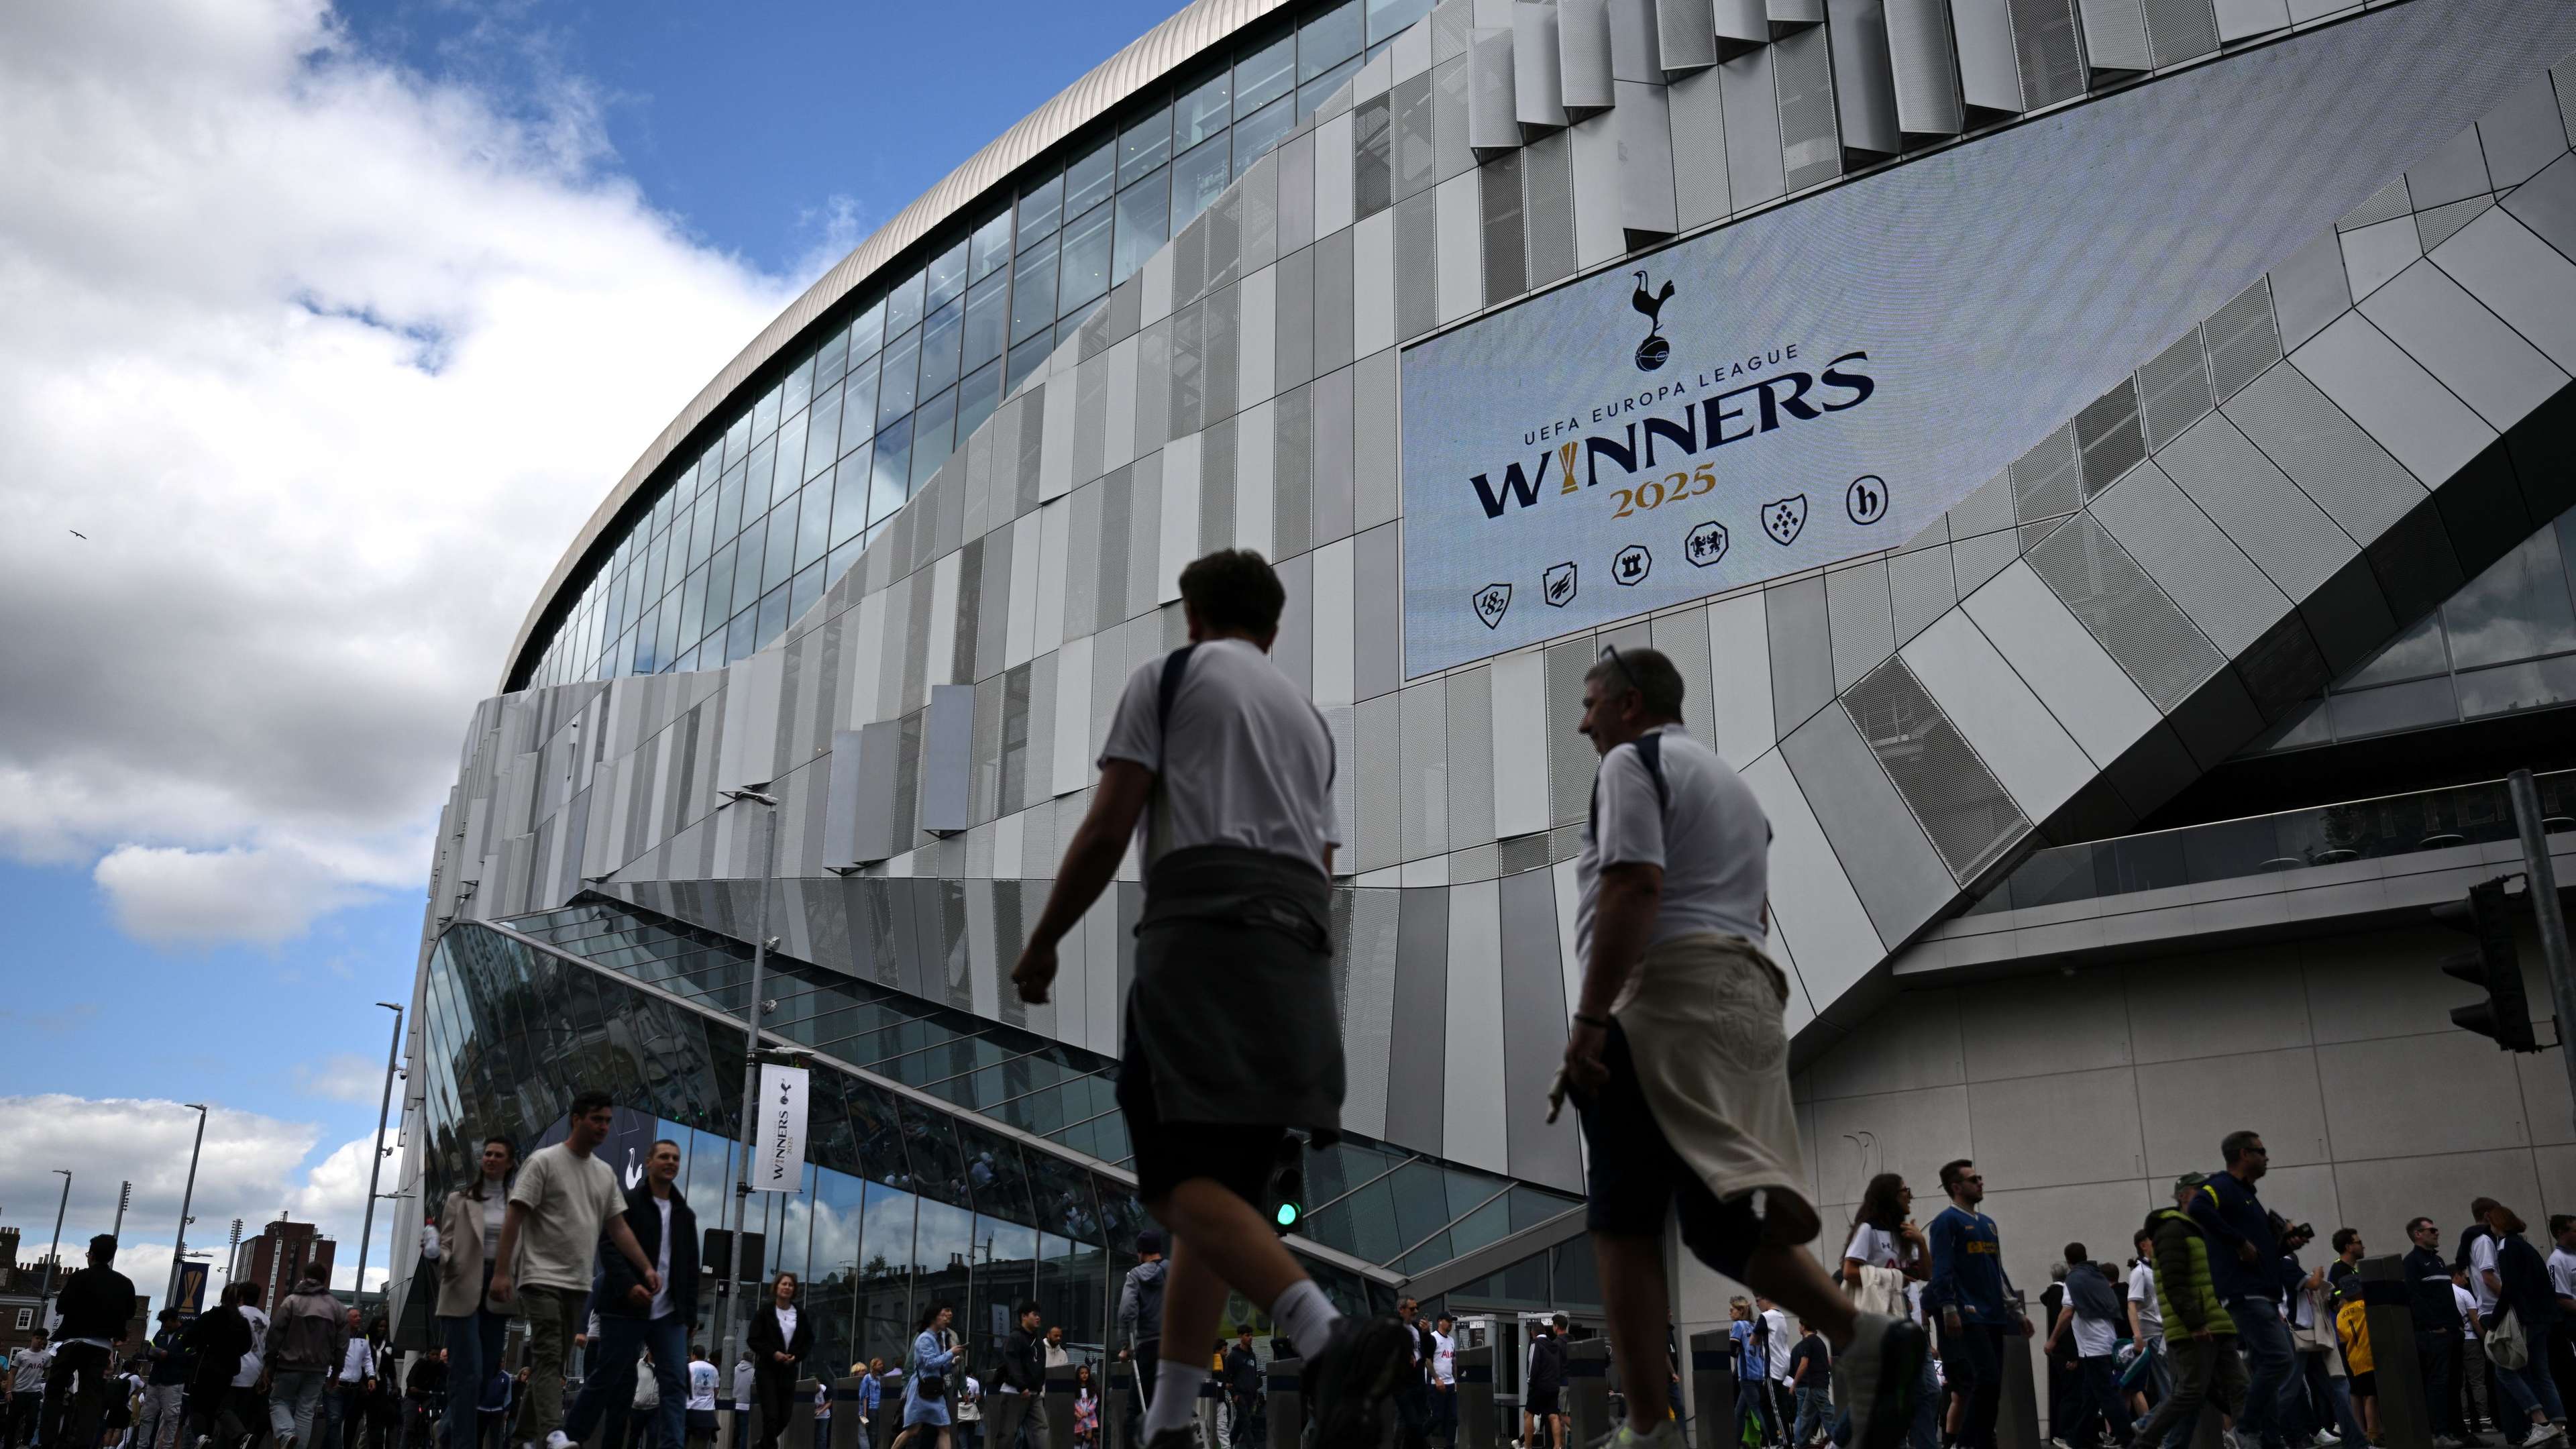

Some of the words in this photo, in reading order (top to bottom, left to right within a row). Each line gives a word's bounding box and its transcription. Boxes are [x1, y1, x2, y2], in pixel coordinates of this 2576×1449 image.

[1470, 351, 1875, 519] WINNERS
[1524, 417, 1580, 445] UEFA
[1593, 382, 1685, 423] EUROPA
[1699, 343, 1799, 387] LEAGUE
[1610, 462, 1716, 519] 2025
[773, 1110, 788, 1180] WINNERS
